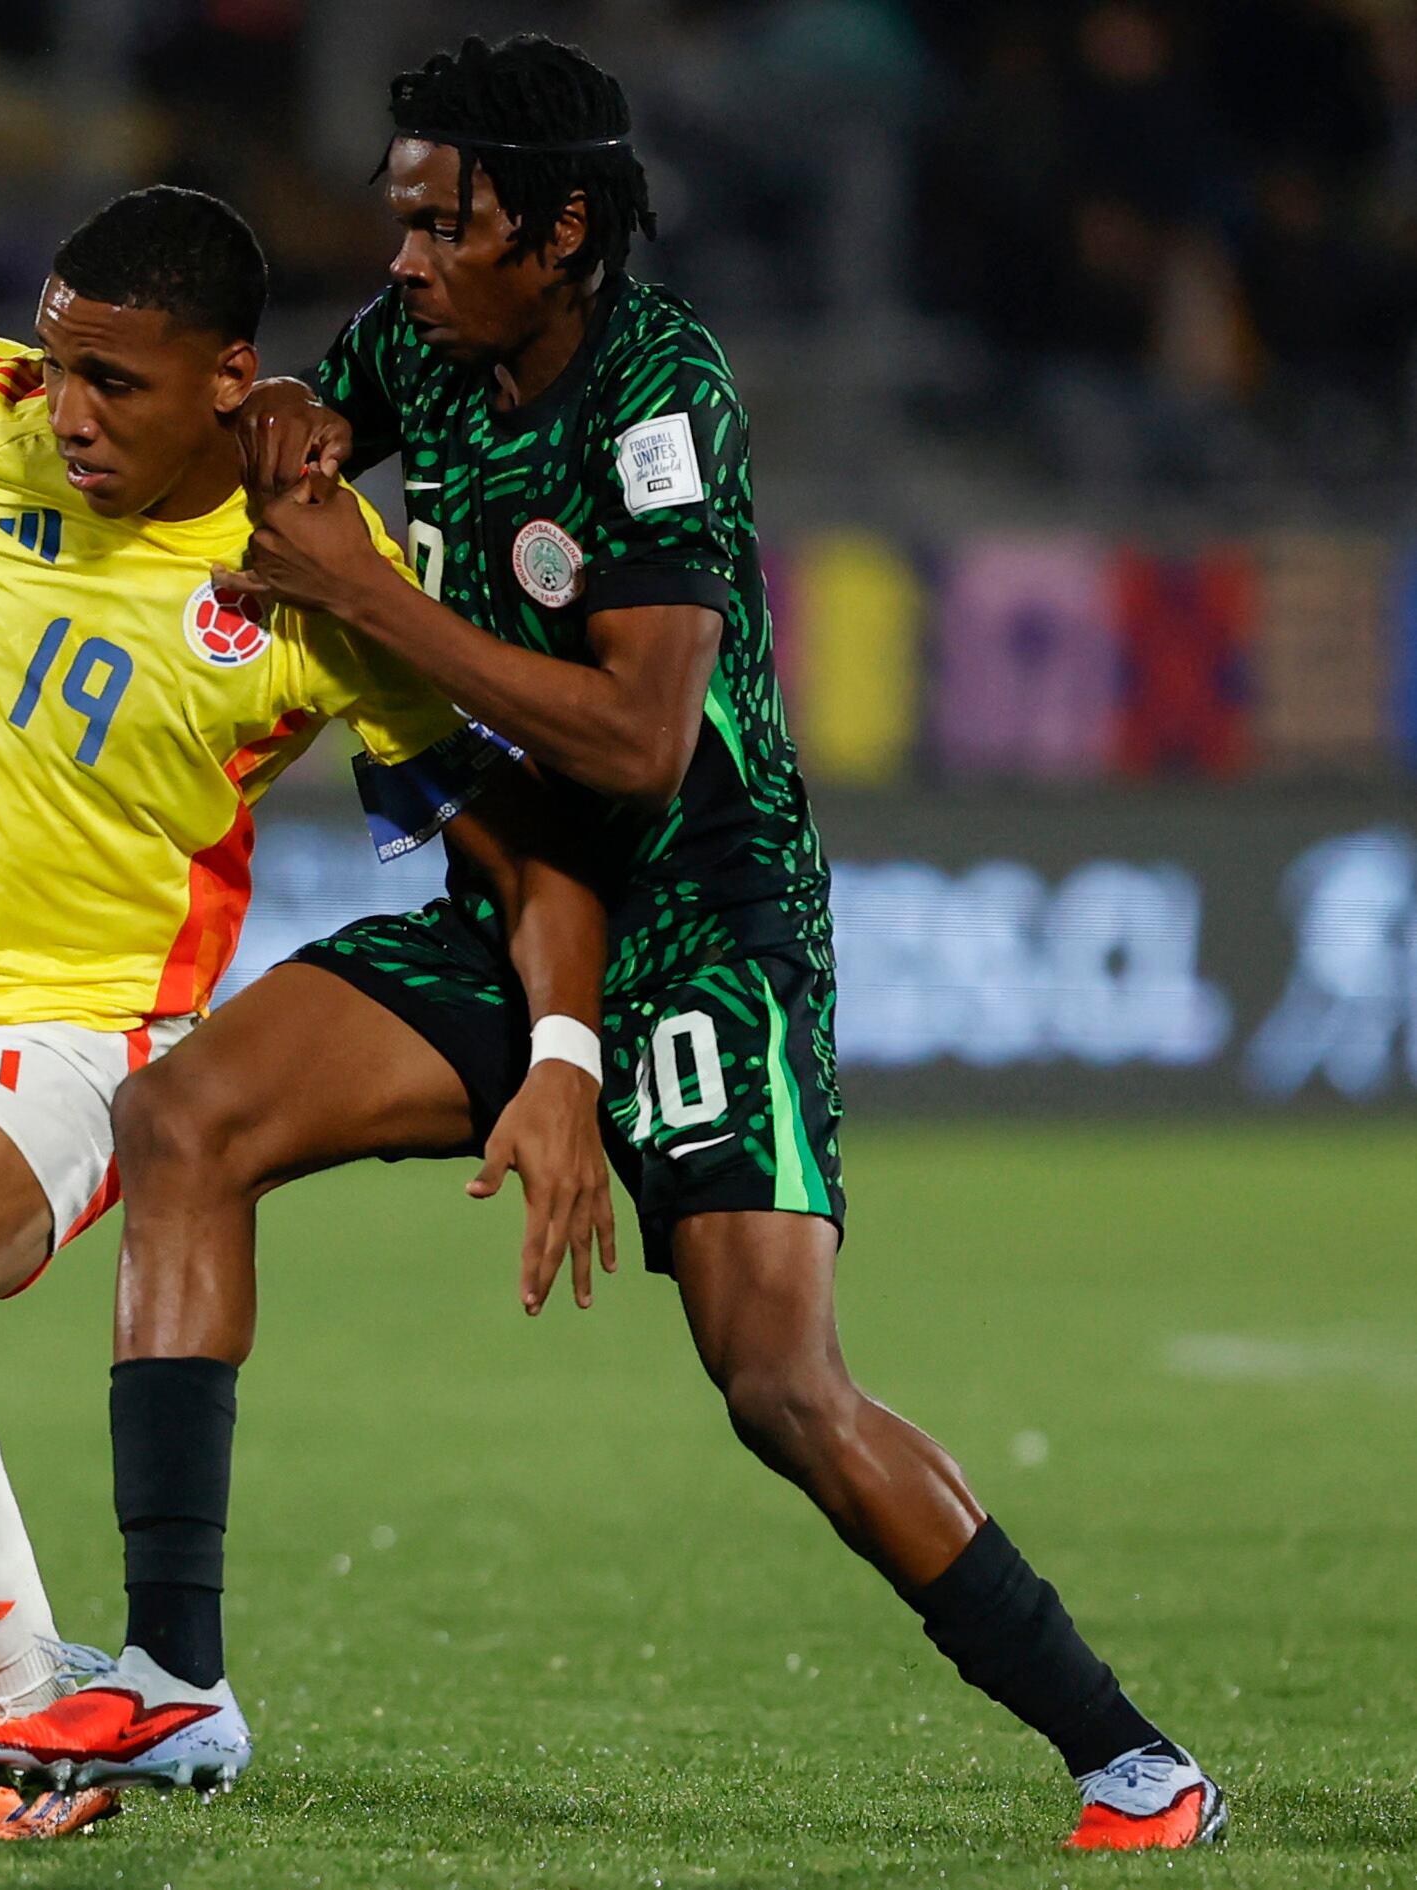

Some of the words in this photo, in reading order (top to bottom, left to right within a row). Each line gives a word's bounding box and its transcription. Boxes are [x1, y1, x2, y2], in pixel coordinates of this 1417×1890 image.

[629, 432, 673, 453] FOOTBALL
[633, 443, 677, 468] UNITES
[650, 459, 682, 477] World
[648, 479, 671, 491] FIFA
[520, 525, 558, 543] FOOTBALL
[8, 616, 134, 767] 19
